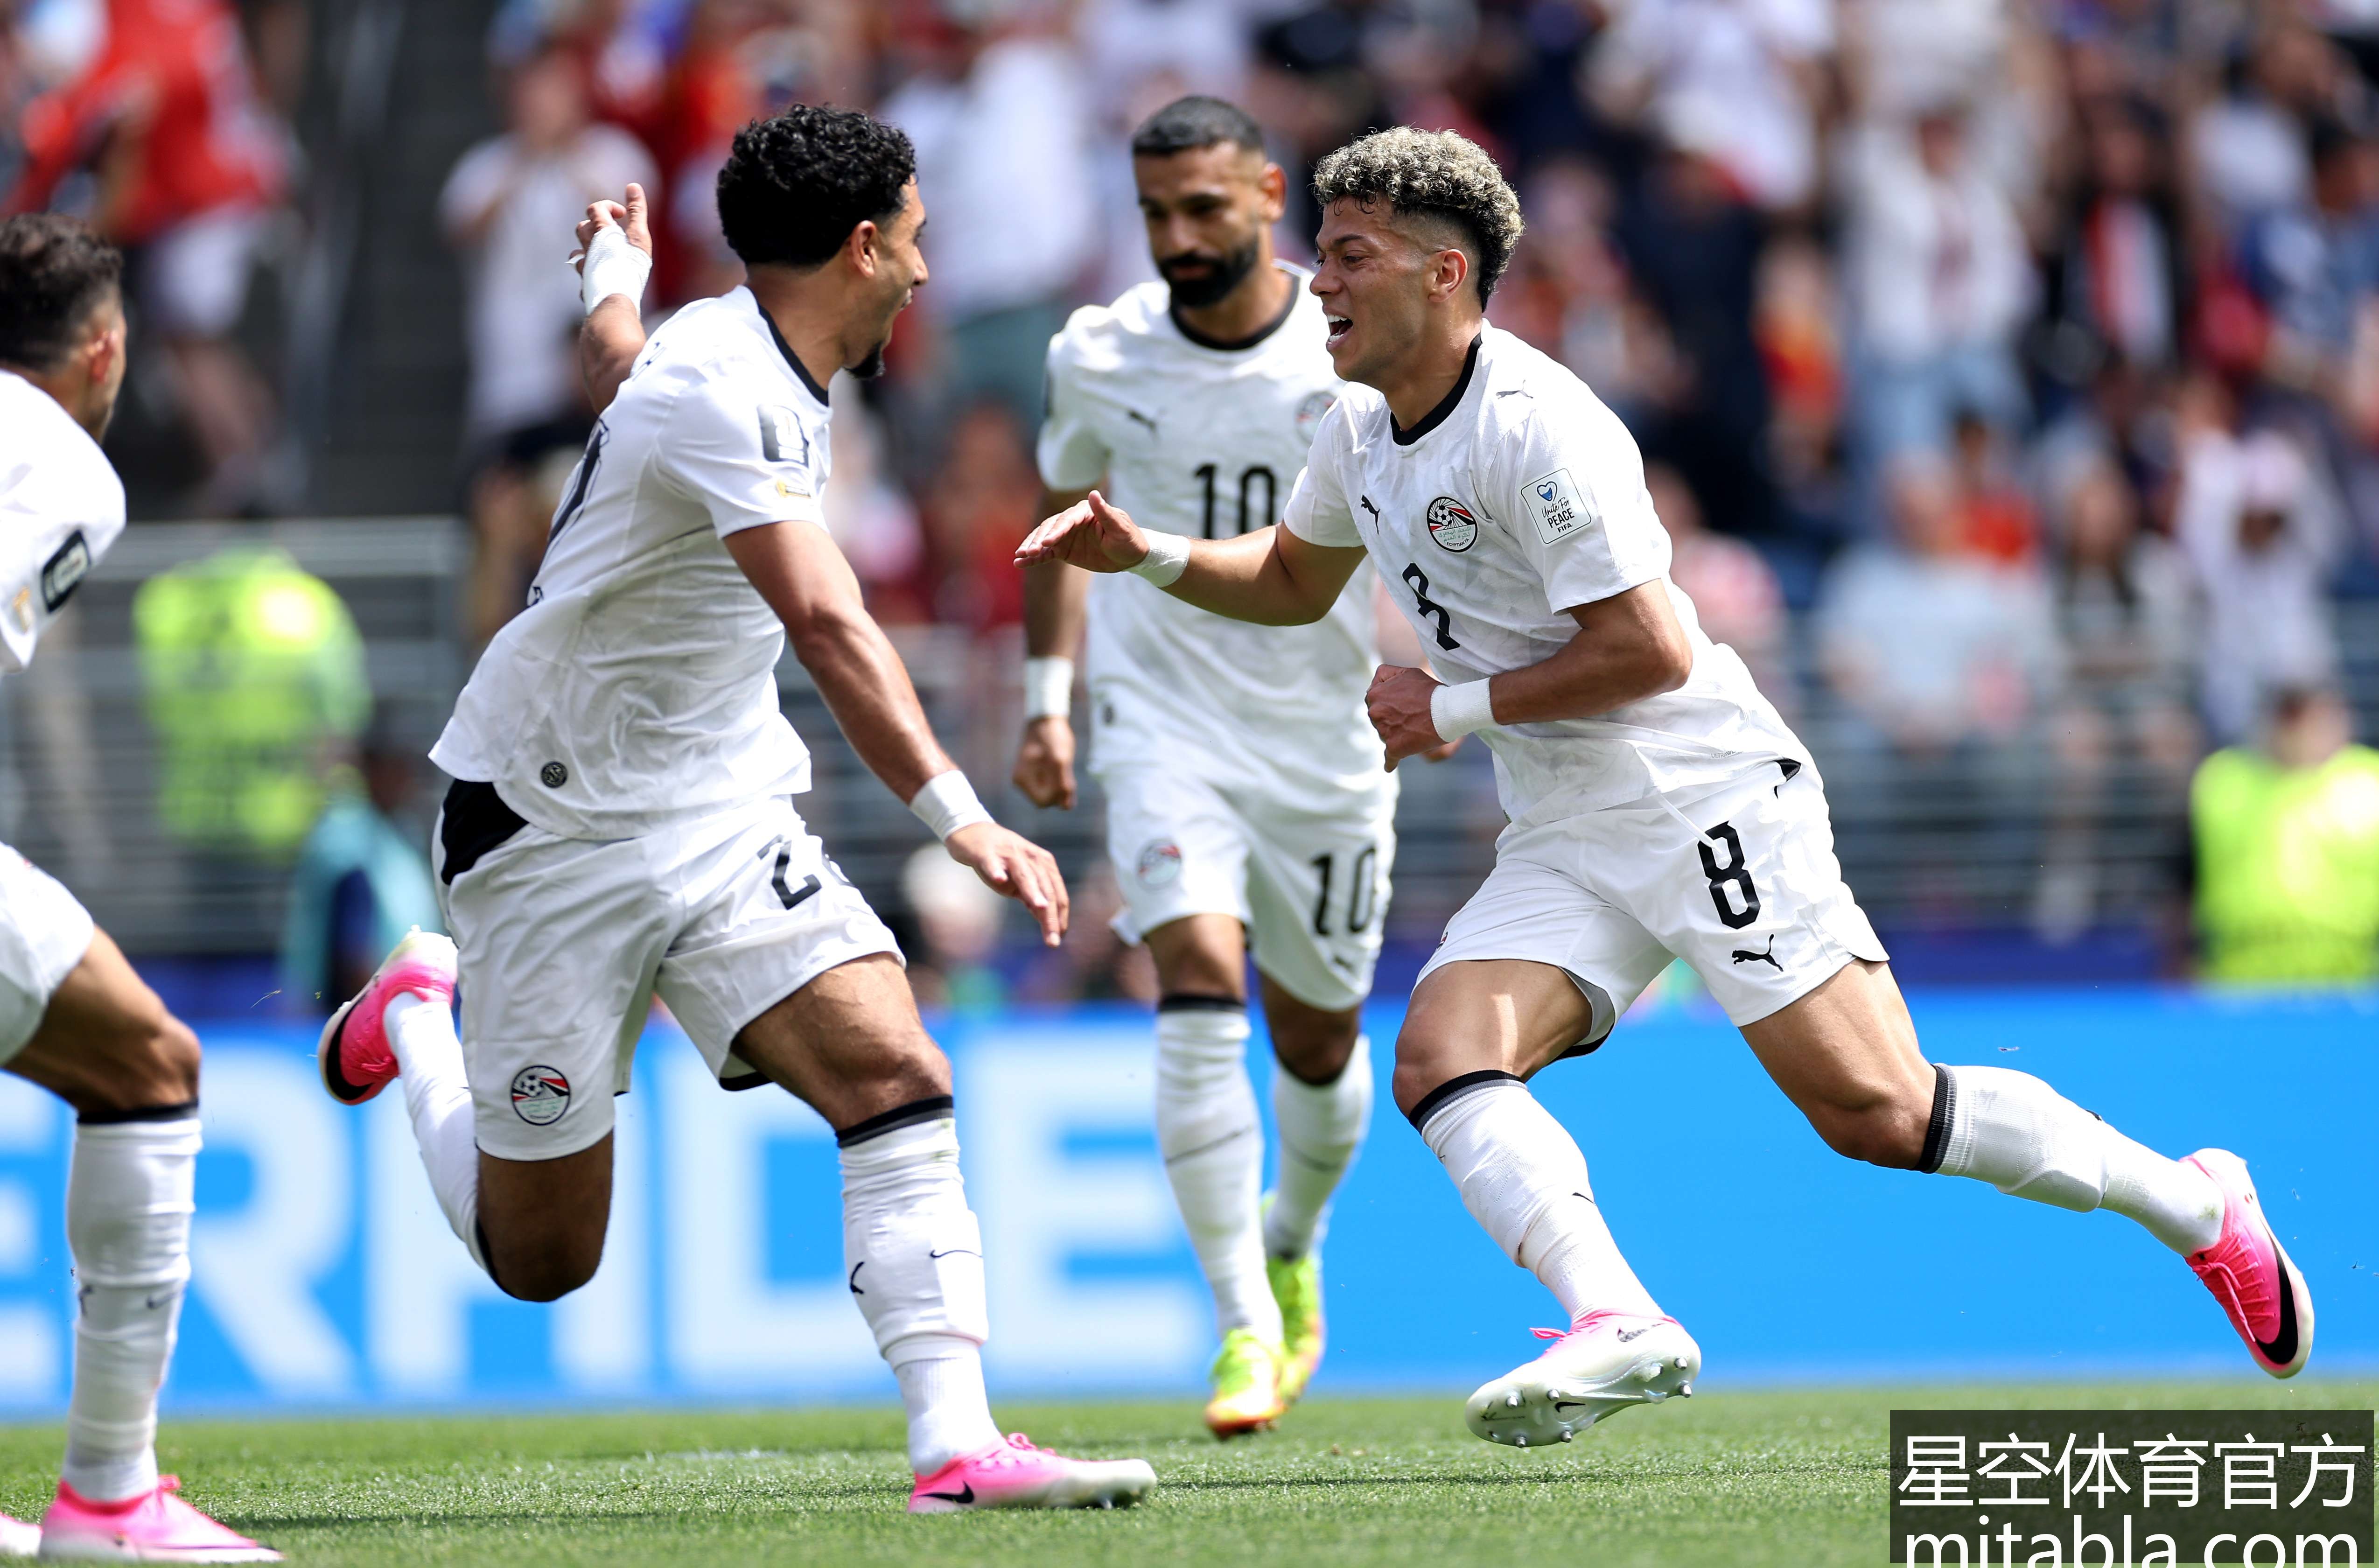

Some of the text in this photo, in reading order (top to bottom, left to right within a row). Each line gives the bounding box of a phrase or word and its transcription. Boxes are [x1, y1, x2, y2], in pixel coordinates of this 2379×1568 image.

[1194, 463, 1278, 539] 10
[1541, 497, 1570, 518] Unite For
[1547, 508, 1575, 528] PEACE
[1557, 523, 1572, 533] FIFA
[1310, 846, 1376, 936] 10
[1697, 820, 1761, 930] 8
